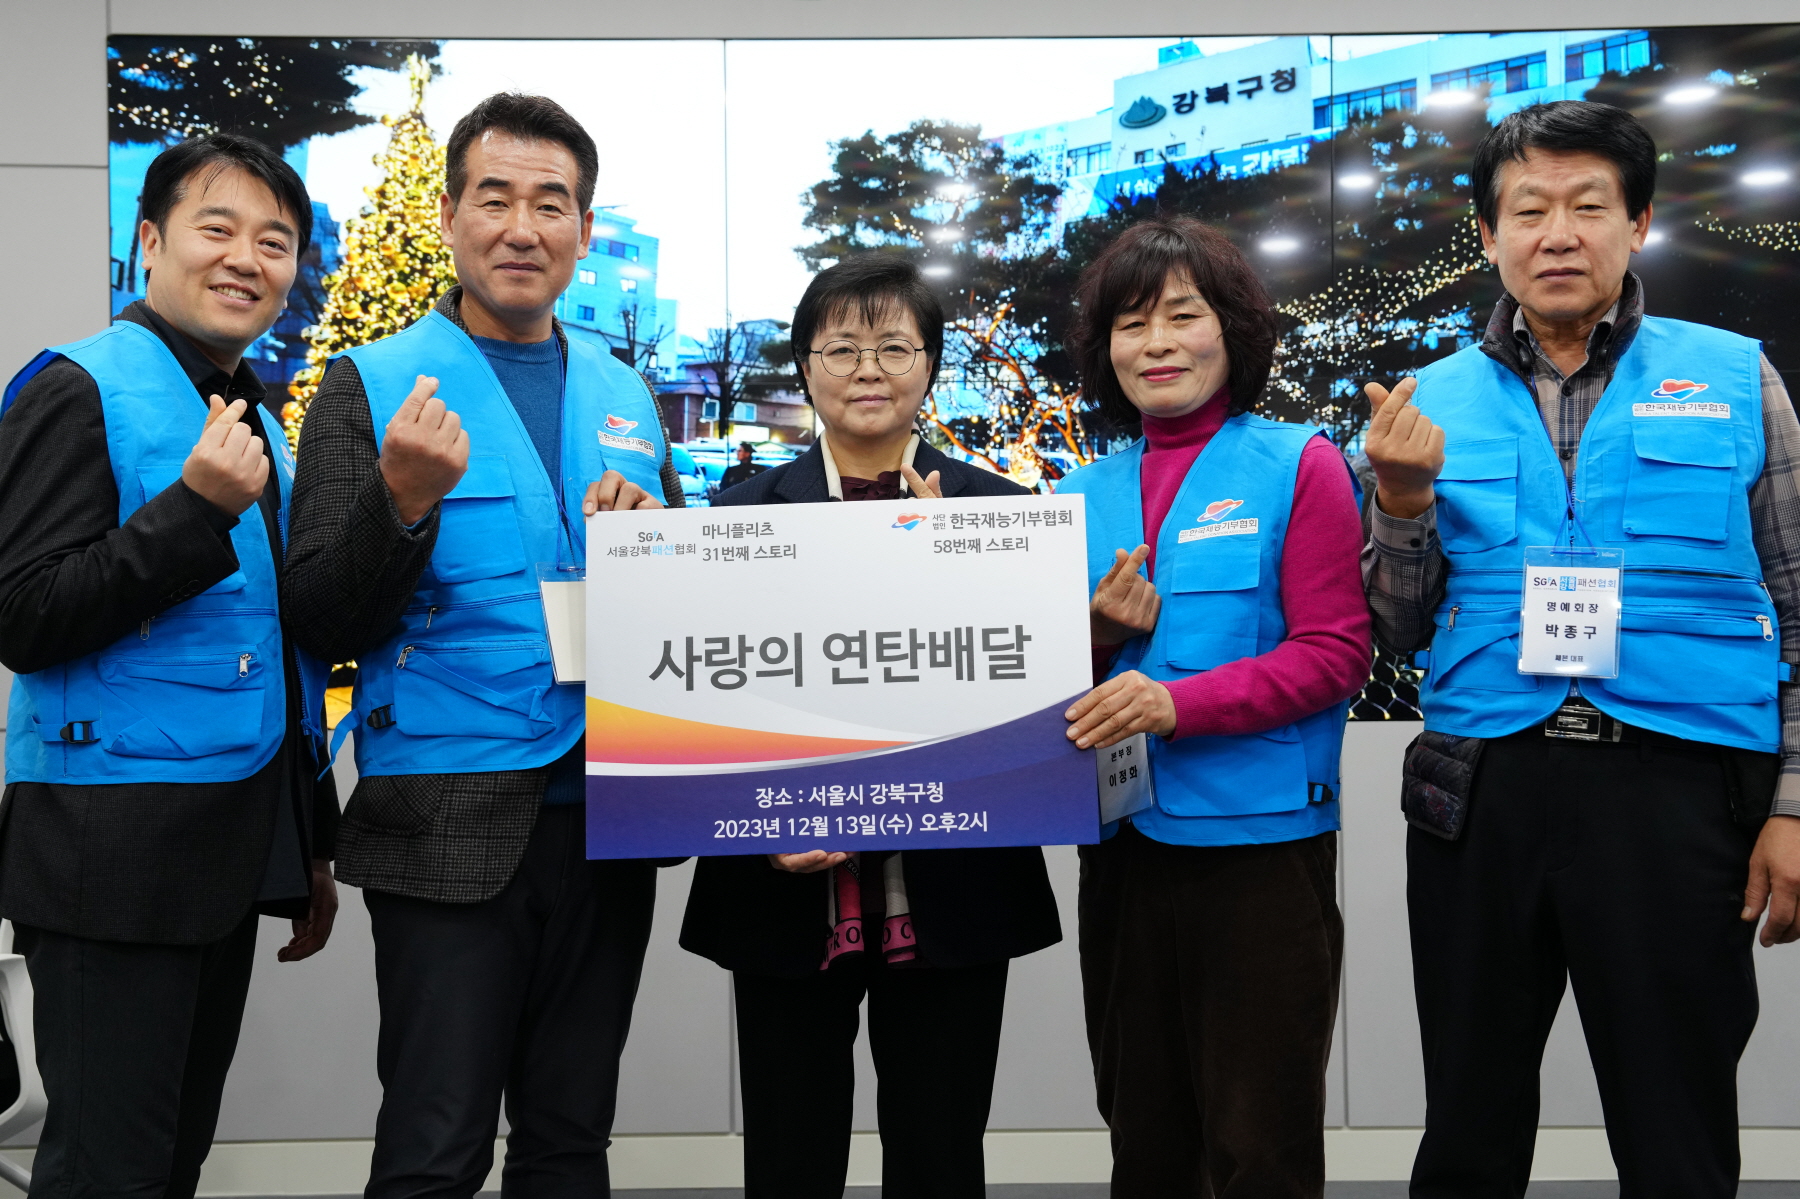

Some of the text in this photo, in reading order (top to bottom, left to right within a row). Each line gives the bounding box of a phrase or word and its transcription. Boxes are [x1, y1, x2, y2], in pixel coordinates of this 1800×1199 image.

[1172, 67, 1297, 115] 강북구청
[1645, 403, 1729, 413] 한국재능기부협회
[932, 522, 946, 530] 법인
[950, 509, 1073, 530] 한국재능기부협회
[702, 522, 775, 540] 마니플리츠
[607, 543, 697, 558] 서울강북패션협회
[702, 544, 797, 562] 31번째 스토리
[934, 536, 1029, 554] 58번째 스토리
[1577, 578, 1616, 588] 패션협회
[1547, 602, 1598, 613] 명예회장
[1545, 624, 1597, 640] 박종구
[648, 624, 1032, 692] 사랑의 연탄배달
[1111, 745, 1132, 762] 본부장
[1109, 764, 1138, 787] 이정화
[755, 788, 793, 808] 장소
[808, 784, 864, 807] 서울시
[869, 781, 944, 806] 강북구청
[714, 811, 988, 839] 2023년 12월 13일(수) 오후2시
